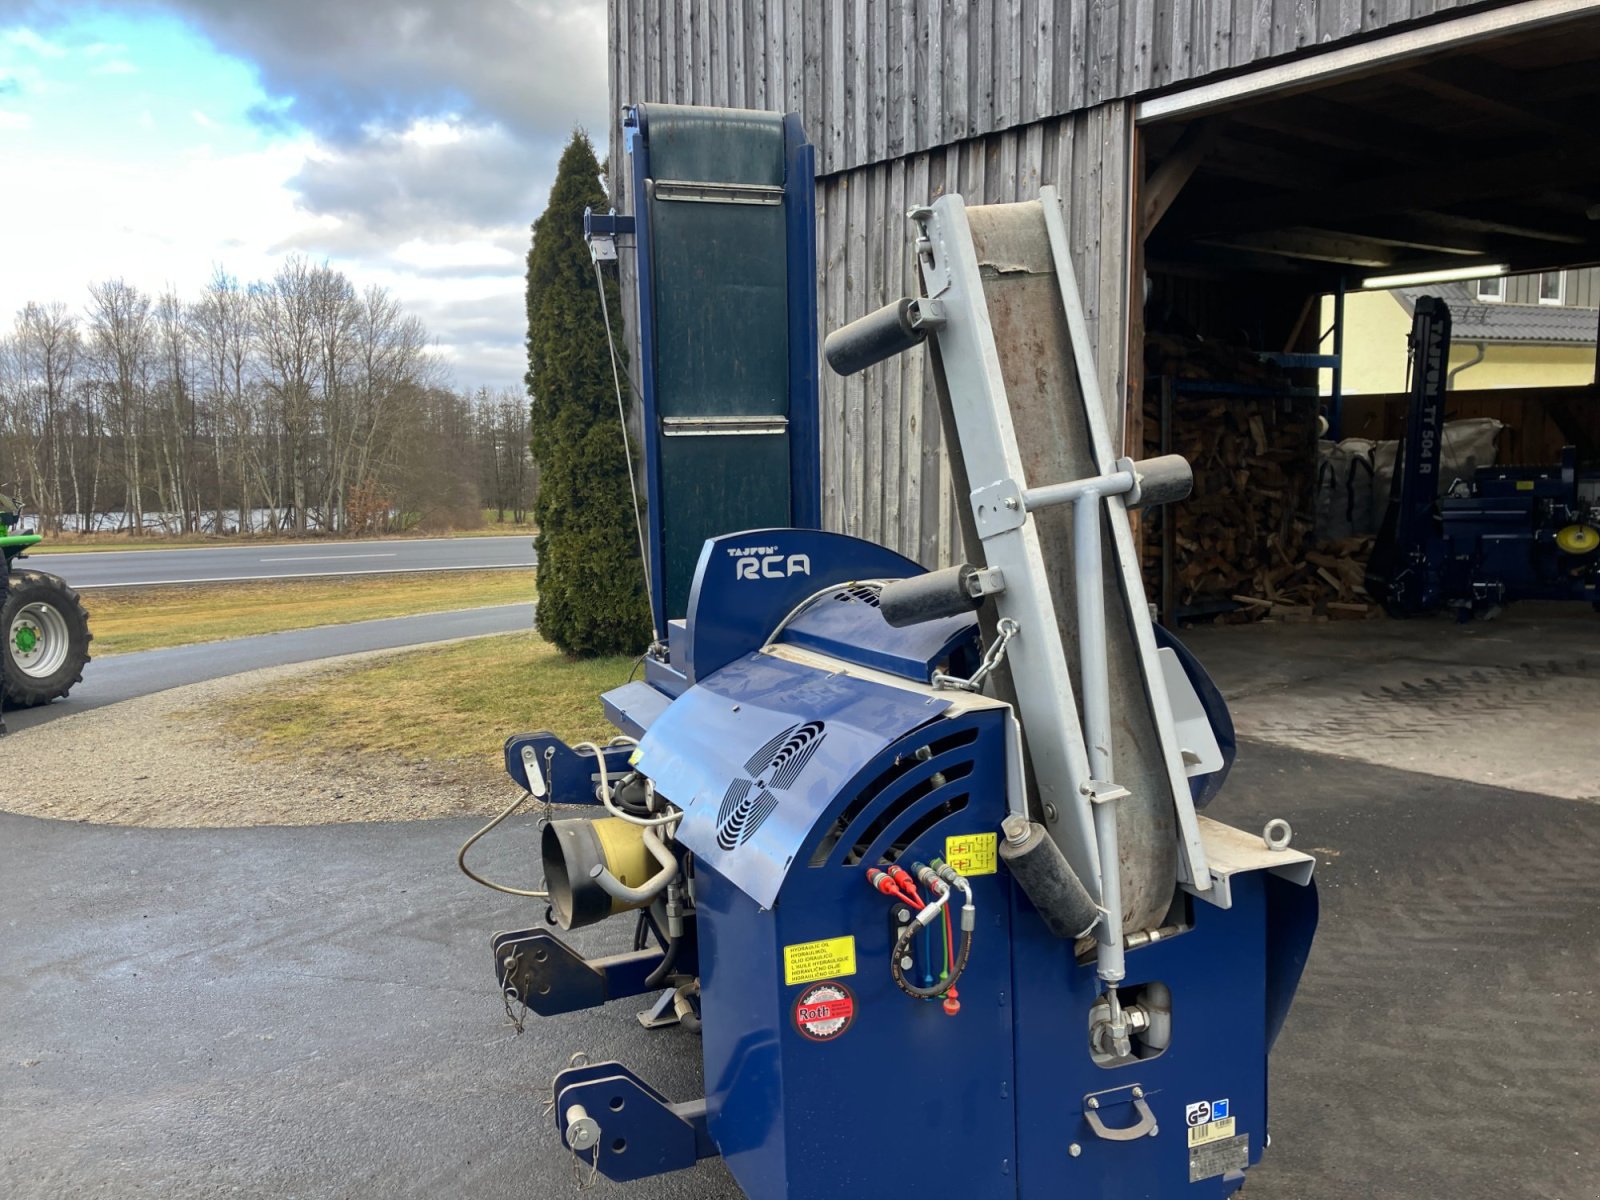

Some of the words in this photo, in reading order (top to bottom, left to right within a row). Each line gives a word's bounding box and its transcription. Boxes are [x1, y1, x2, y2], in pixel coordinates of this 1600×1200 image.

[1424, 319, 1444, 396] TAJFUN
[1423, 405, 1437, 425] TT
[1421, 430, 1434, 458] 504
[1419, 463, 1432, 474] R
[736, 554, 810, 580] RCA
[790, 943, 820, 953] HYDRAULIC
[791, 957, 804, 965] OLIO
[805, 953, 833, 962] IDRAULICO
[812, 955, 849, 966] HYDRAULIQUE
[799, 1005, 830, 1021] Roth
[1188, 1102, 1209, 1125] GS
